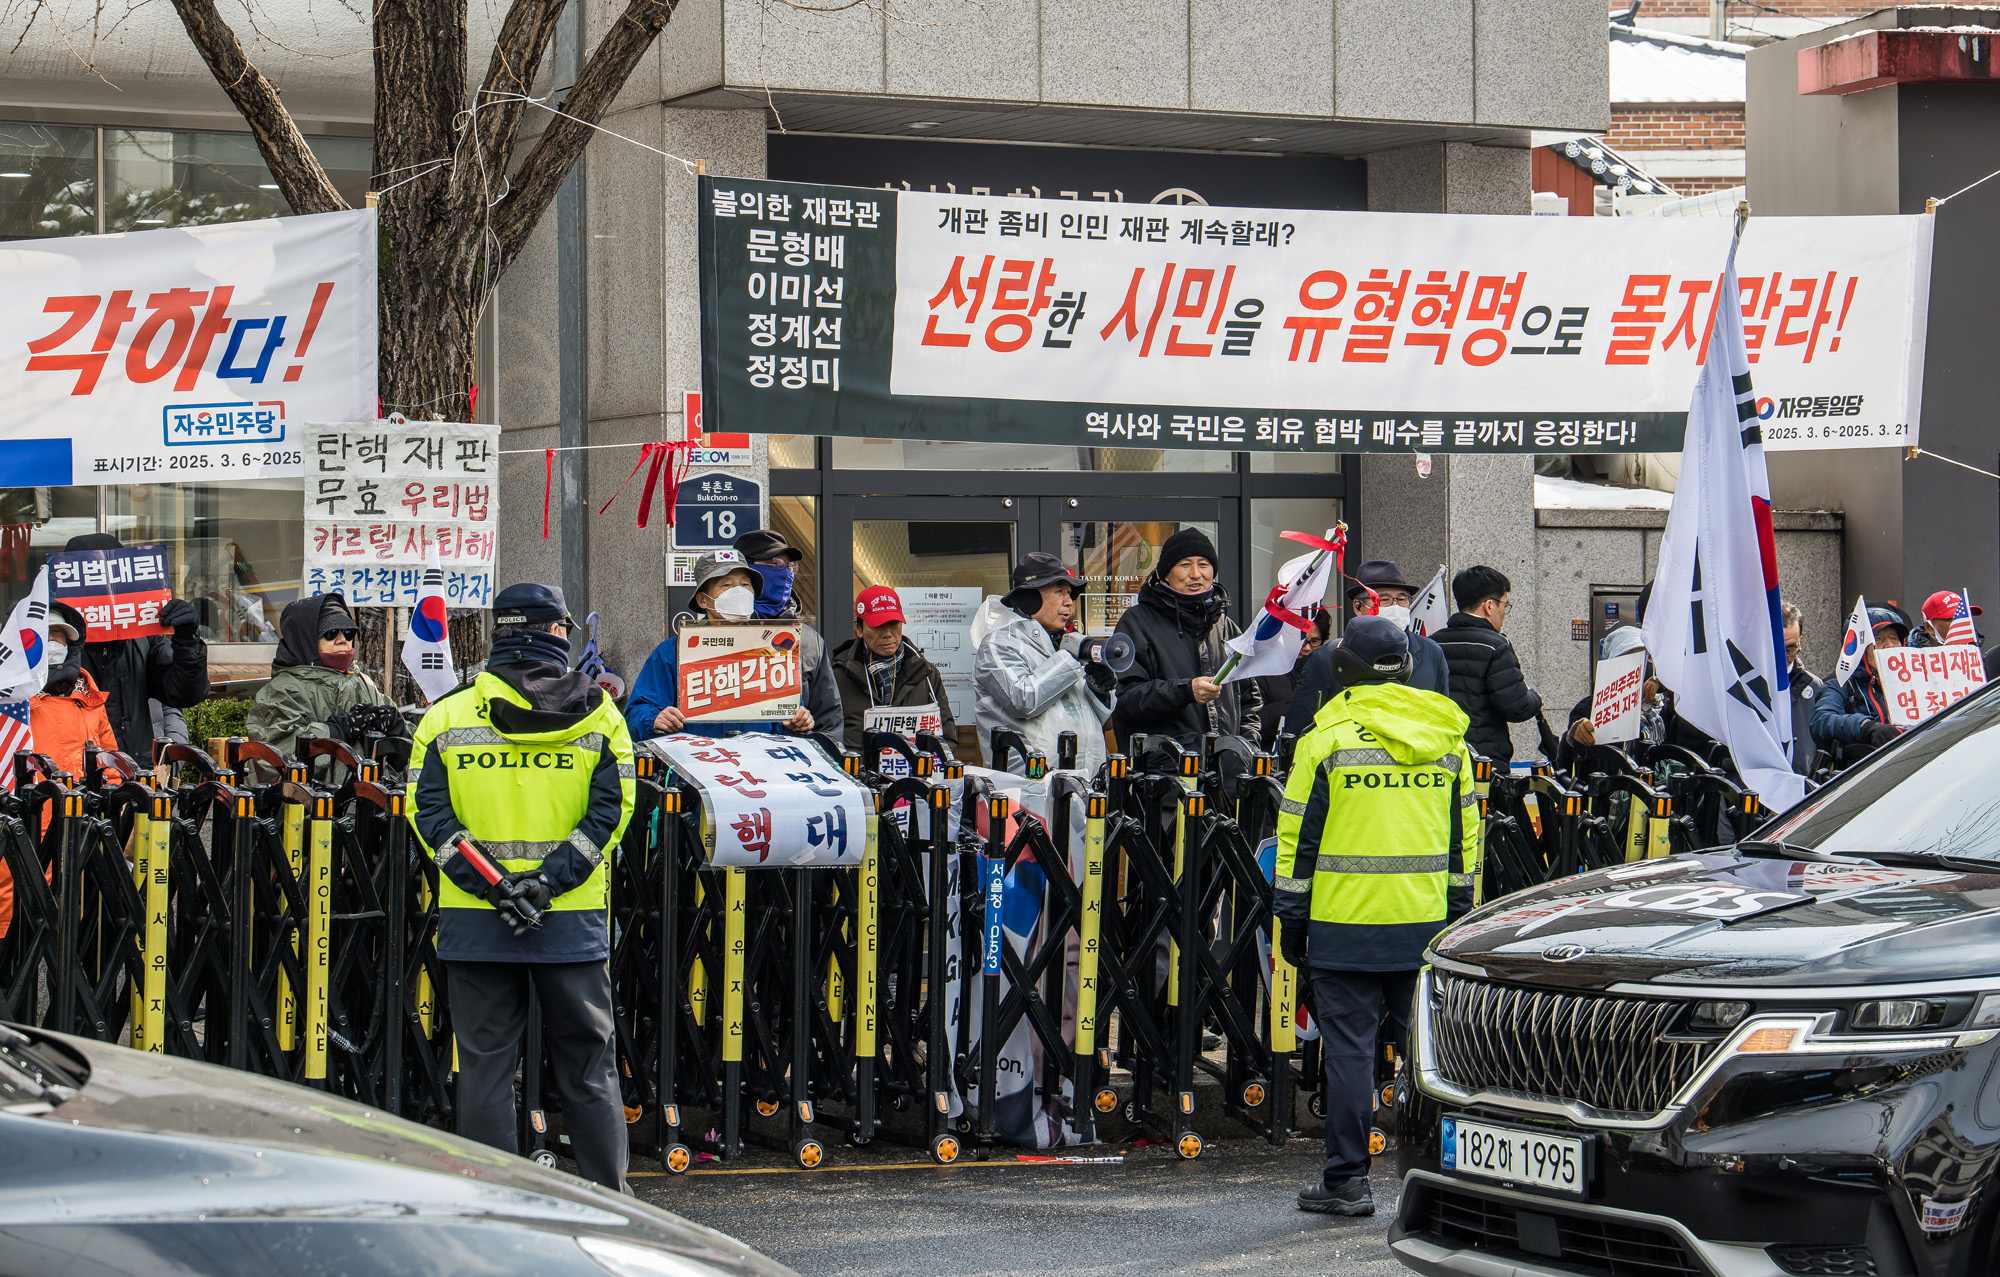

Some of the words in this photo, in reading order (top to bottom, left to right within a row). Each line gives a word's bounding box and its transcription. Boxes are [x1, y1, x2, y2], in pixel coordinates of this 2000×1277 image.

[712, 190, 791, 221] 불의한
[802, 197, 880, 229] 재판관
[938, 206, 988, 234] 개판
[998, 208, 1049, 238] 좀비
[1060, 212, 1109, 240] 인민
[1120, 216, 1169, 245] 재판
[1181, 218, 1295, 248] 계속할래?
[746, 229, 844, 269] 문형배
[747, 272, 844, 310] 이미선
[921, 255, 1086, 353] 선량한
[1100, 262, 1264, 358] 시민을
[1283, 268, 1589, 366] 유혈혁명으로
[25, 282, 336, 396] 각하다!
[747, 314, 843, 351] 정계선
[746, 354, 840, 392] 정정미
[173, 410, 277, 437] 자유민주당
[1777, 395, 1864, 419] 자유통일당
[1086, 412, 1160, 441] 역사와
[1170, 414, 1245, 443] 국민은
[1256, 415, 1305, 443] 회유
[1315, 418, 1362, 445] 협박
[1372, 419, 1442, 445] 매수를
[1456, 420, 1524, 446] 끝까지
[1533, 420, 1637, 447] 응징한다!
[1768, 428, 1802, 440] 2025.
[1807, 427, 1819, 439] 3.
[1879, 425, 1890, 436] 3.
[1896, 424, 1909, 436] 21
[93, 456, 163, 474] 표시기간:
[169, 452, 215, 470] 2025.
[221, 453, 237, 469] 3.
[317, 433, 388, 473] 탄핵
[687, 451, 730, 463] SECOM
[316, 478, 387, 516] 무효
[697, 494, 739, 502] Bukchon-ro
[701, 481, 734, 494] 북촌로
[313, 523, 397, 559] 카르텔
[700, 510, 737, 540] 18
[54, 555, 165, 589] 헌법대로!
[76, 599, 168, 631] 핵무효!
[702, 637, 734, 646] 국민의힘
[686, 650, 796, 710] 탄핵각하
[1594, 664, 1642, 708] 자유민주주의
[1594, 700, 1620, 728] 무조건
[456, 752, 574, 770] POLICE
[1344, 772, 1446, 789] POLICE
[317, 866, 329, 967] POLICE
[866, 858, 877, 952] POLICE
[1603, 884, 1802, 917] CBS
[1080, 861, 1102, 1031] 질서유지선
[865, 970, 875, 1032] LINE
[1281, 969, 1290, 1029] LINE
[316, 986, 326, 1052] LINE
[1459, 1128, 1513, 1172] 182하
[1520, 1139, 1576, 1184] 1995
